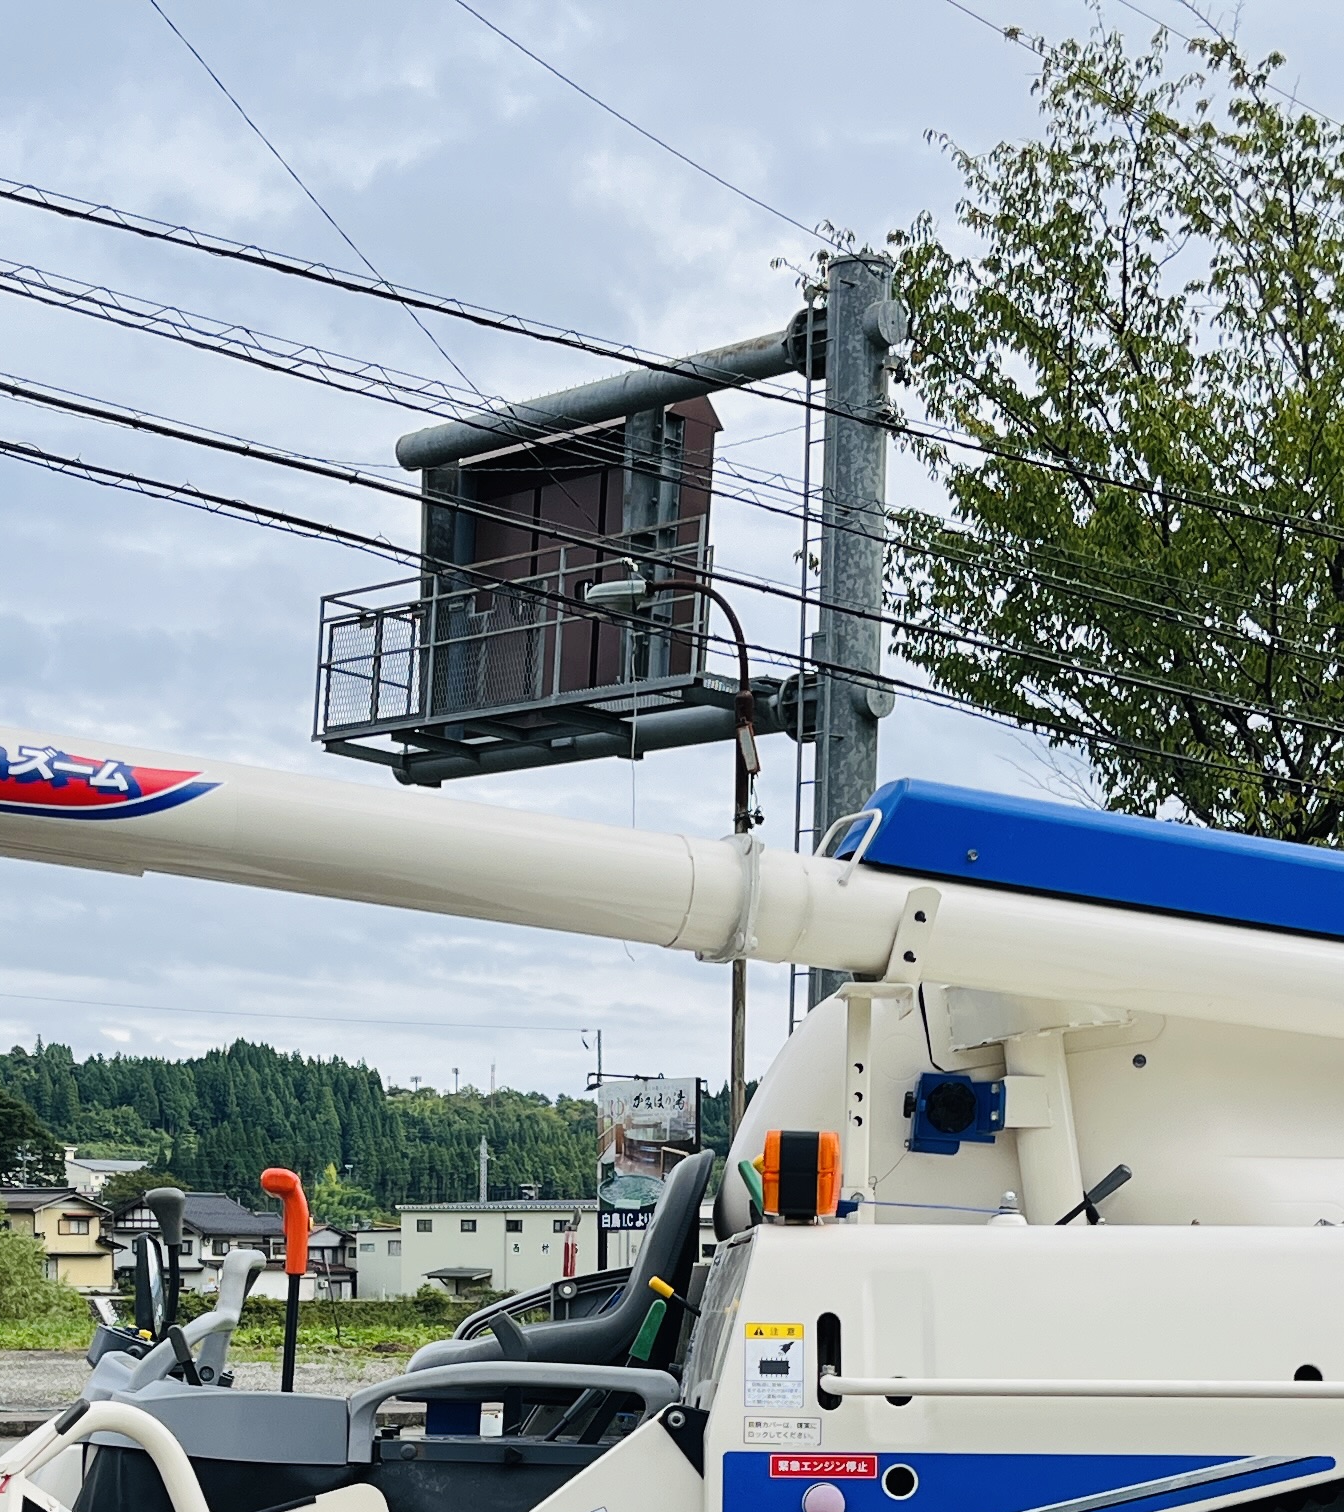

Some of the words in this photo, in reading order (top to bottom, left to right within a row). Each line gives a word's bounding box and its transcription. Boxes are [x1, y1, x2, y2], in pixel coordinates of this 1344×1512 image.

[778, 1460, 868, 1473] 緊急エンジン停止
